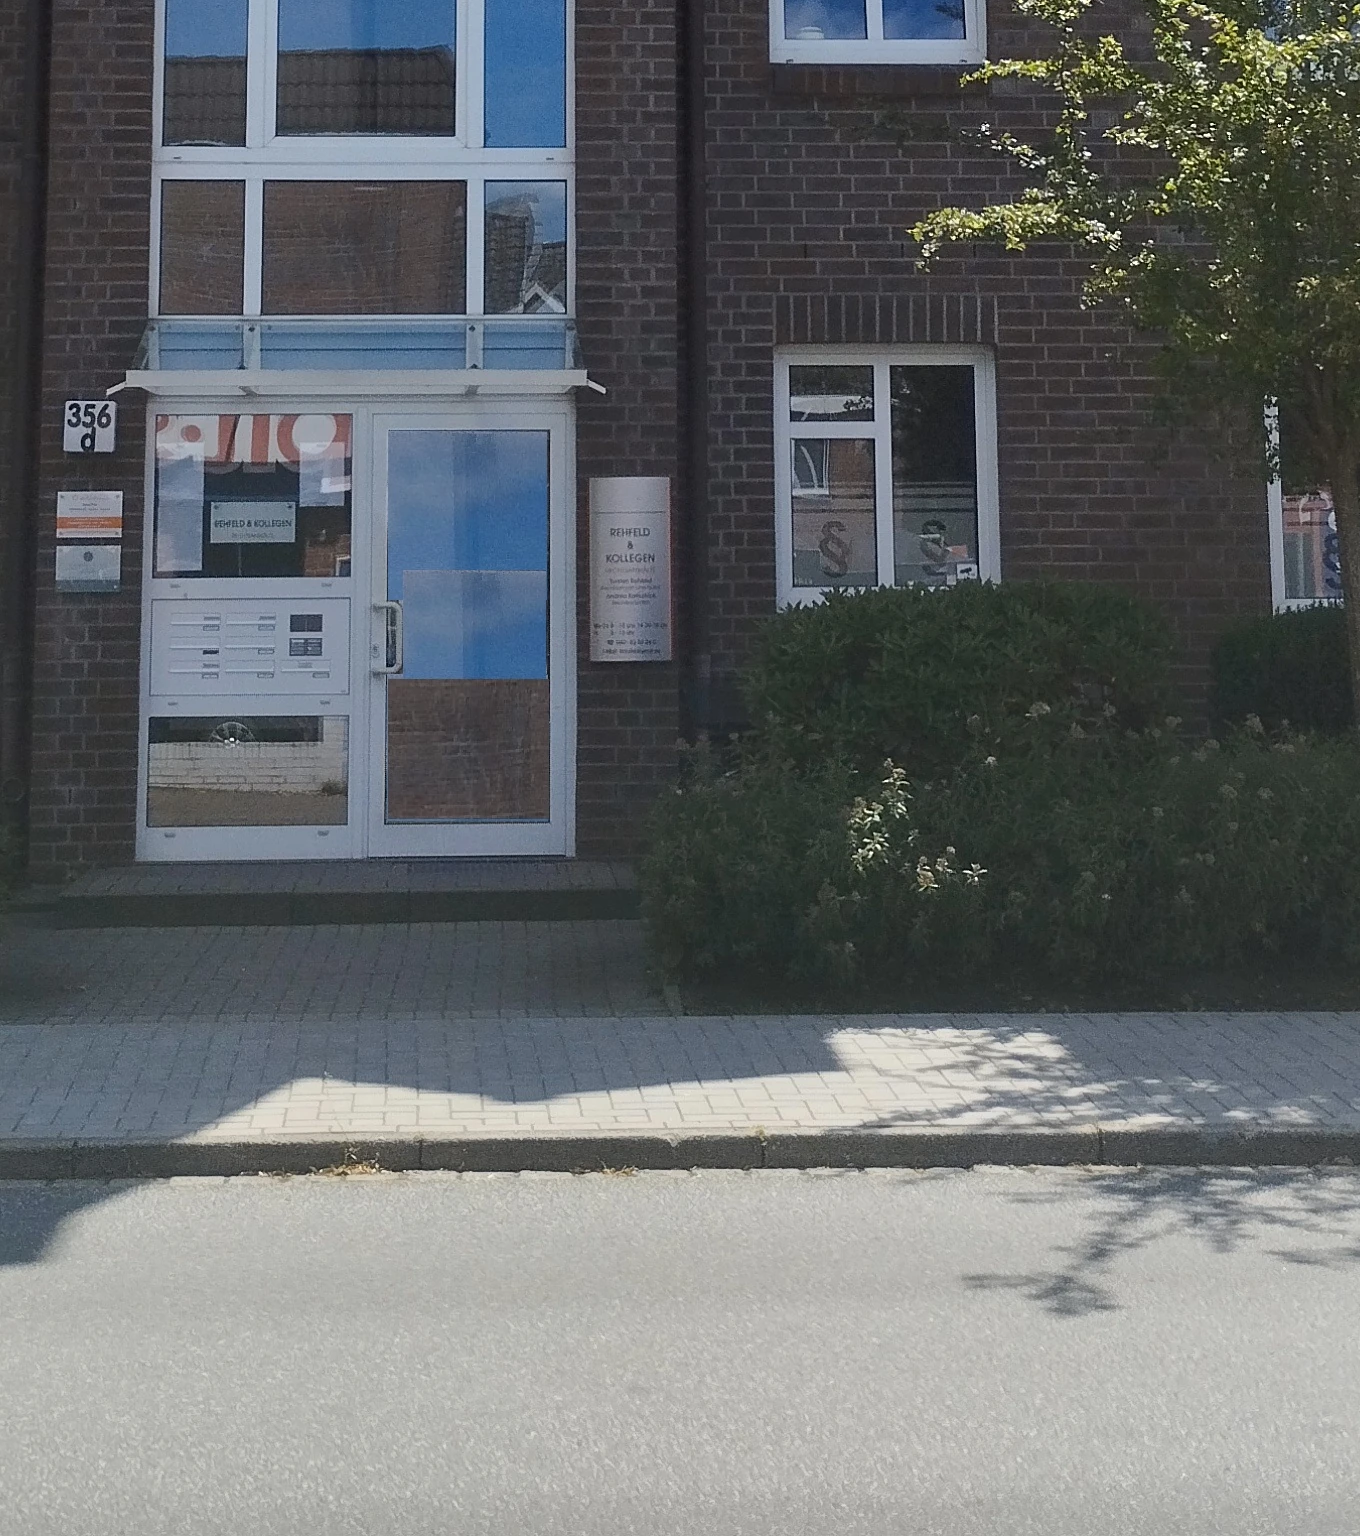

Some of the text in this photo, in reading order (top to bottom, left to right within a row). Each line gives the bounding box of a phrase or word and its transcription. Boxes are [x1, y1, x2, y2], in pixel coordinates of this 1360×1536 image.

[67, 402, 112, 429] 356
[80, 426, 96, 452] d
[246, 519, 252, 527] &
[254, 519, 292, 528] KOLLEGEN
[609, 527, 651, 537] REHFELD
[627, 540, 634, 550] &
[605, 553, 655, 563] KOLLEGEN
